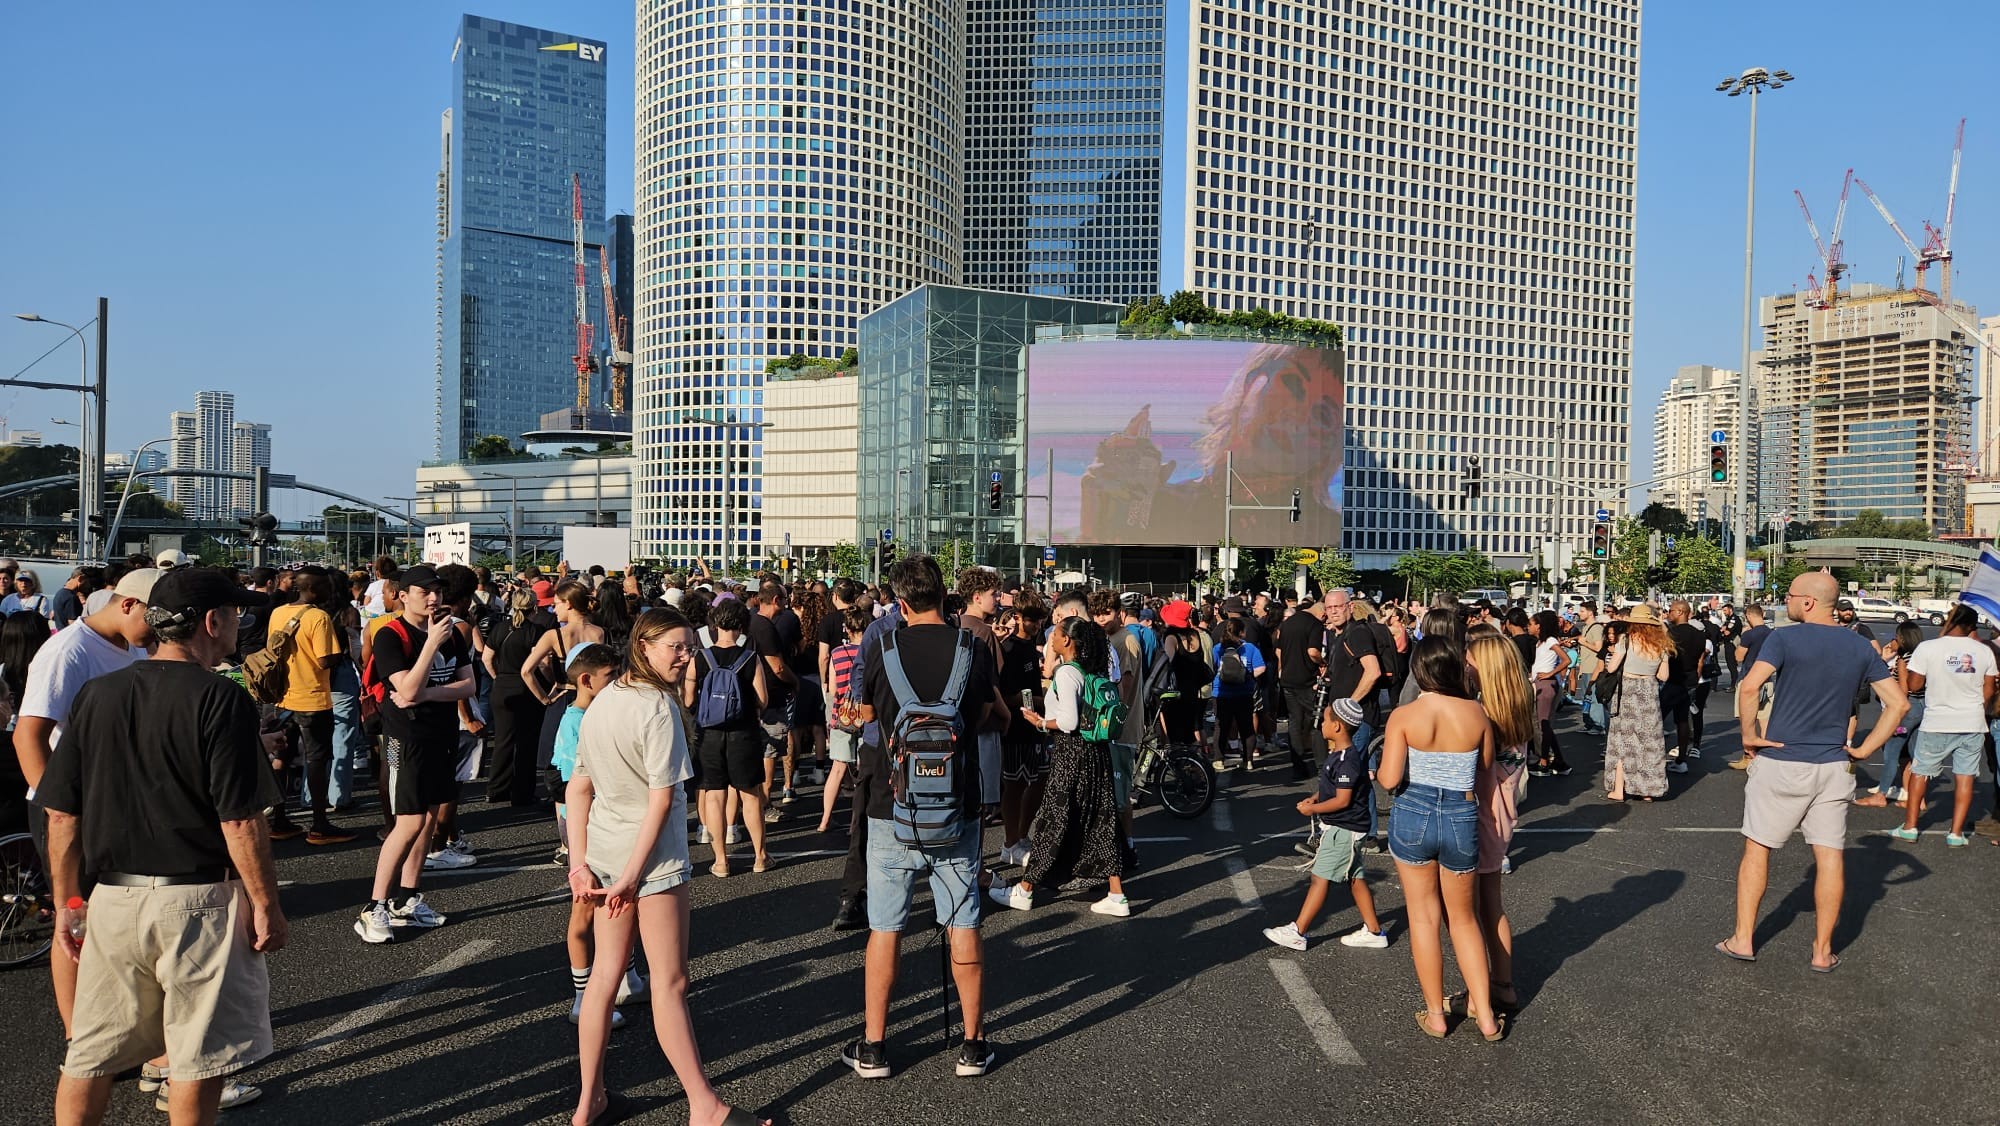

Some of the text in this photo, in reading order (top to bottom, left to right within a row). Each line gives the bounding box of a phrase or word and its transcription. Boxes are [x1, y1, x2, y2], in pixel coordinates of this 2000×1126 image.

[579, 43, 604, 62] EY
[448, 528, 466, 545] בלי
[451, 552, 464, 565] אין
[915, 763, 945, 777] LiveU
